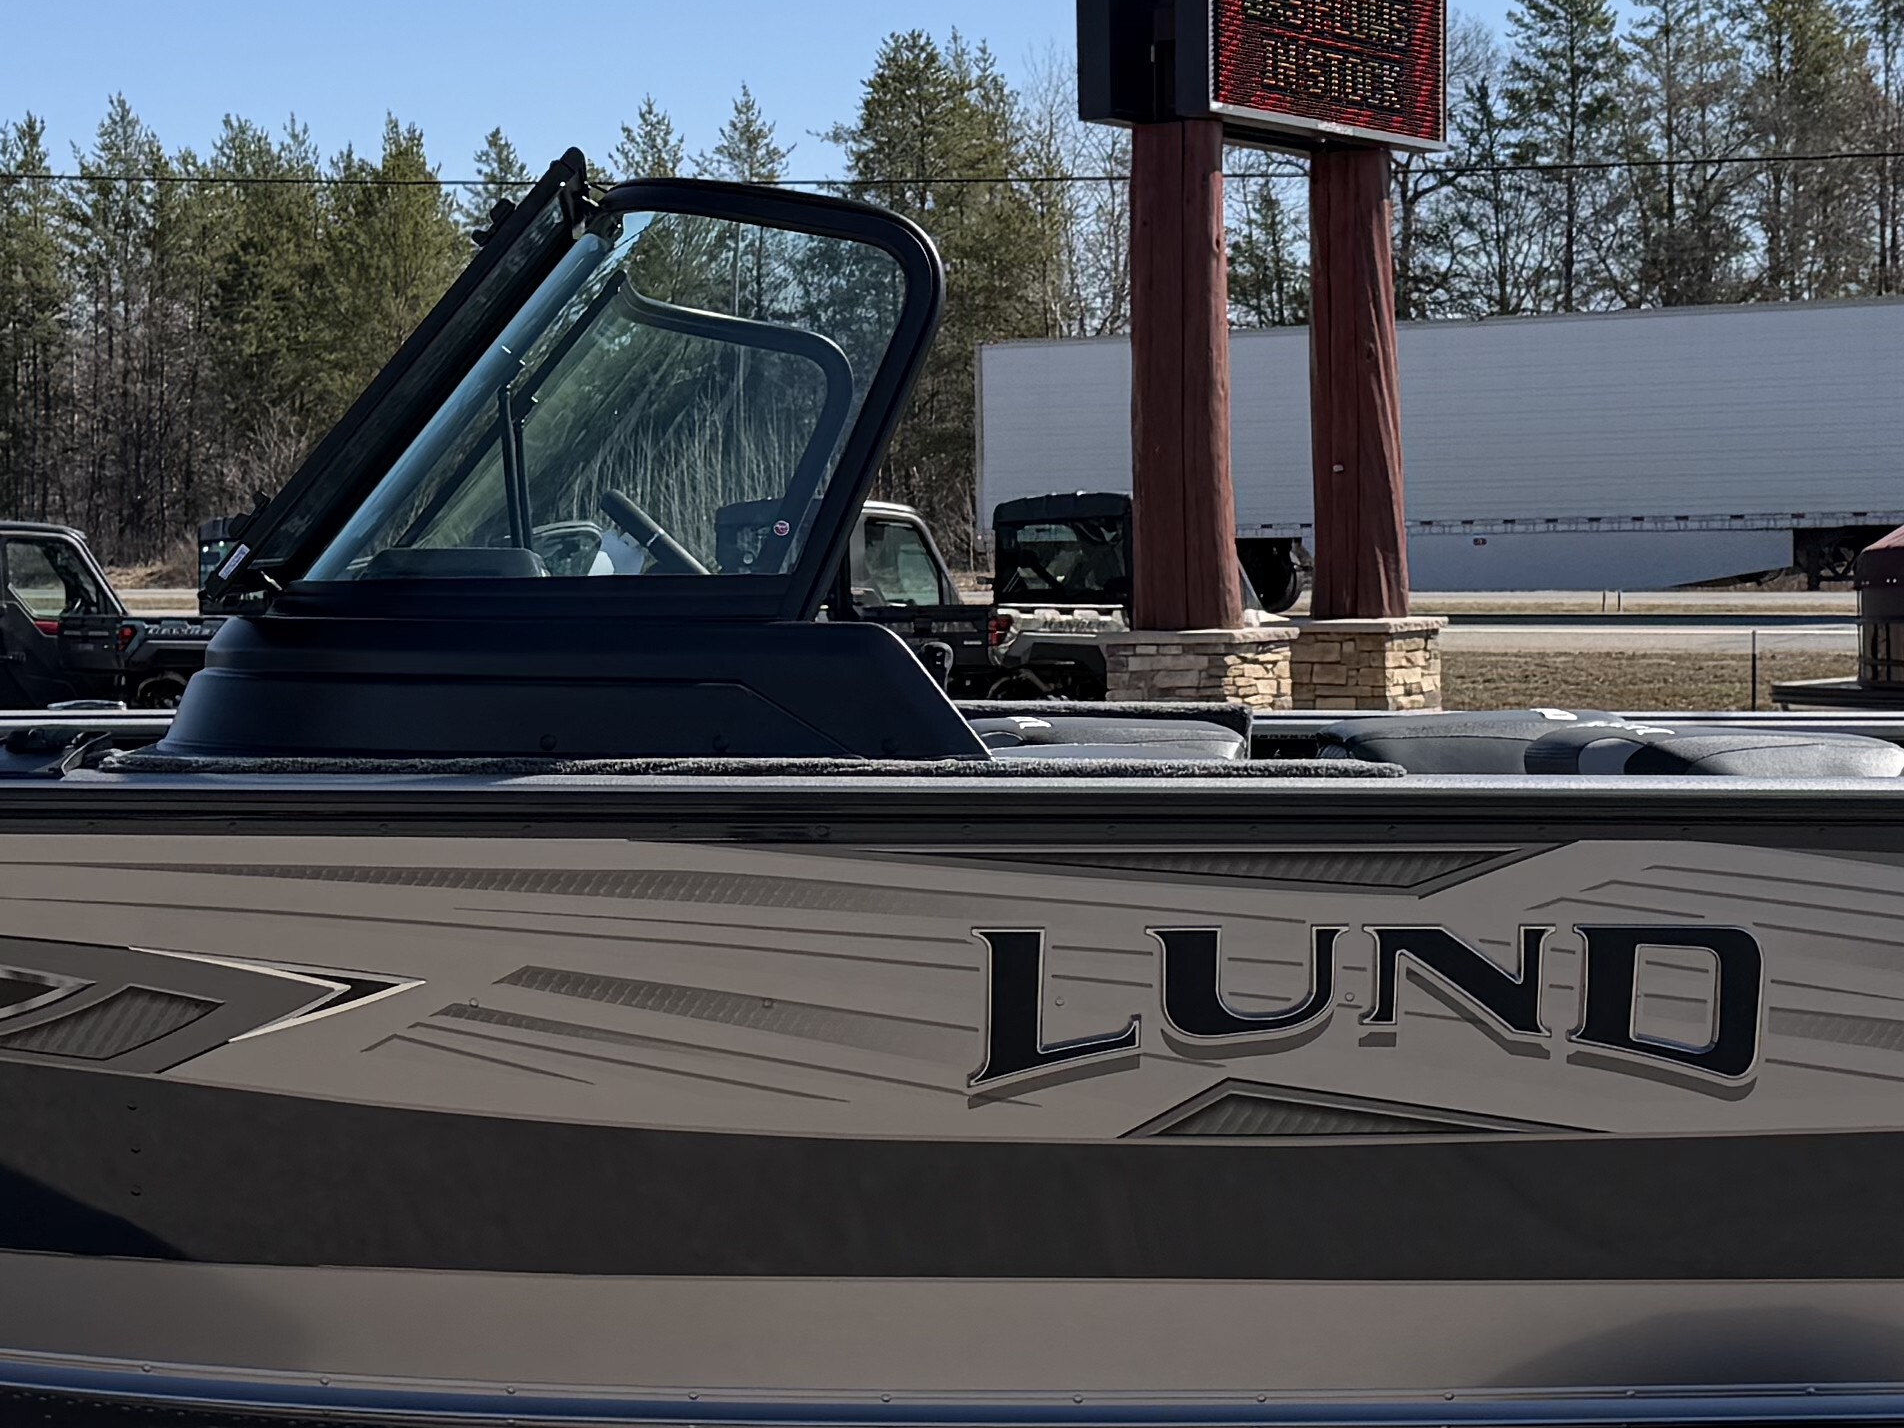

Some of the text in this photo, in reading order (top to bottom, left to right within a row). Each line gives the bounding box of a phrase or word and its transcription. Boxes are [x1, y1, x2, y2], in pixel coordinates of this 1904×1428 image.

[1261, 36, 1402, 110] IN STOCK
[966, 924, 1765, 1098] LUND
